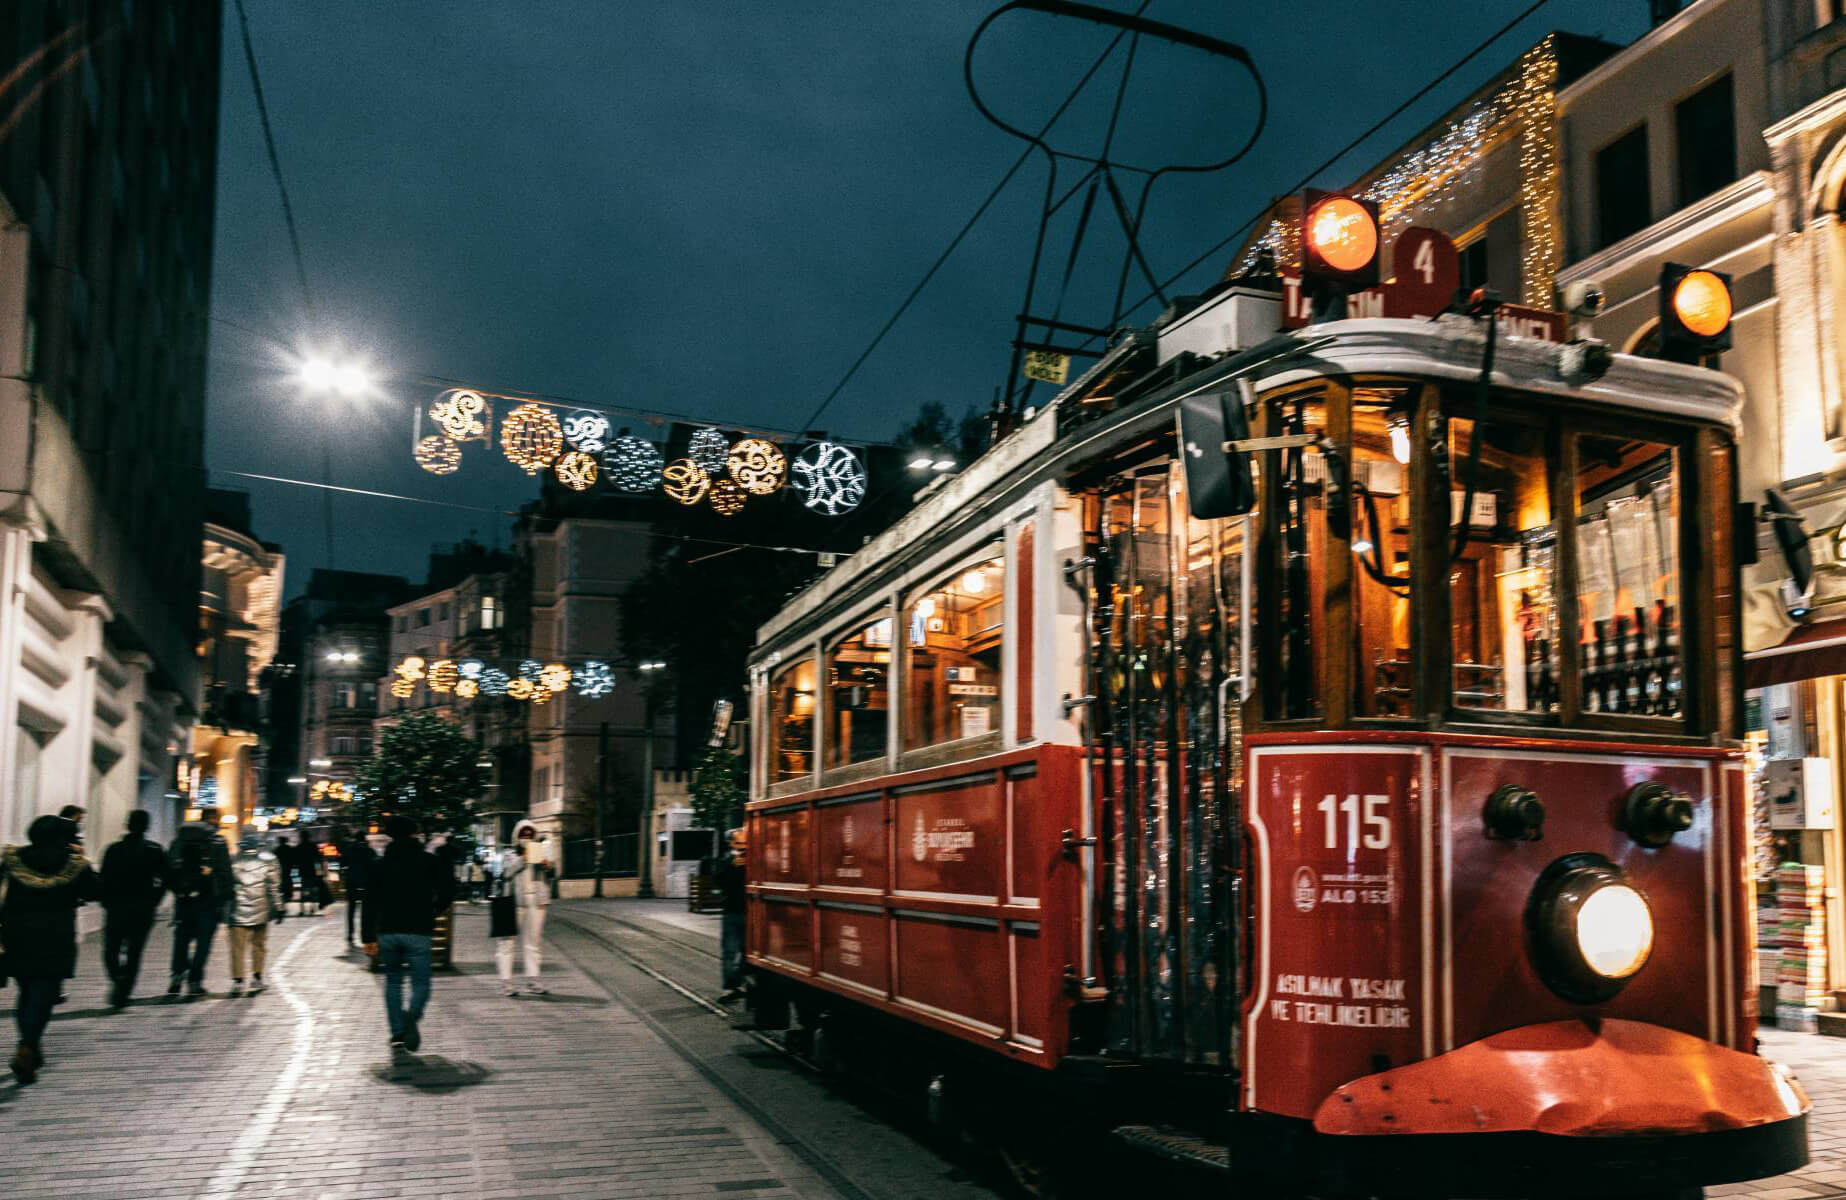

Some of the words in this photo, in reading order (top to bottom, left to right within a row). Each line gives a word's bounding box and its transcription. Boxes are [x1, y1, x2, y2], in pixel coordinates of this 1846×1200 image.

[1413, 239, 1434, 284] 4
[1317, 794, 1391, 849] 115
[1350, 978, 1406, 1000] YASAK
